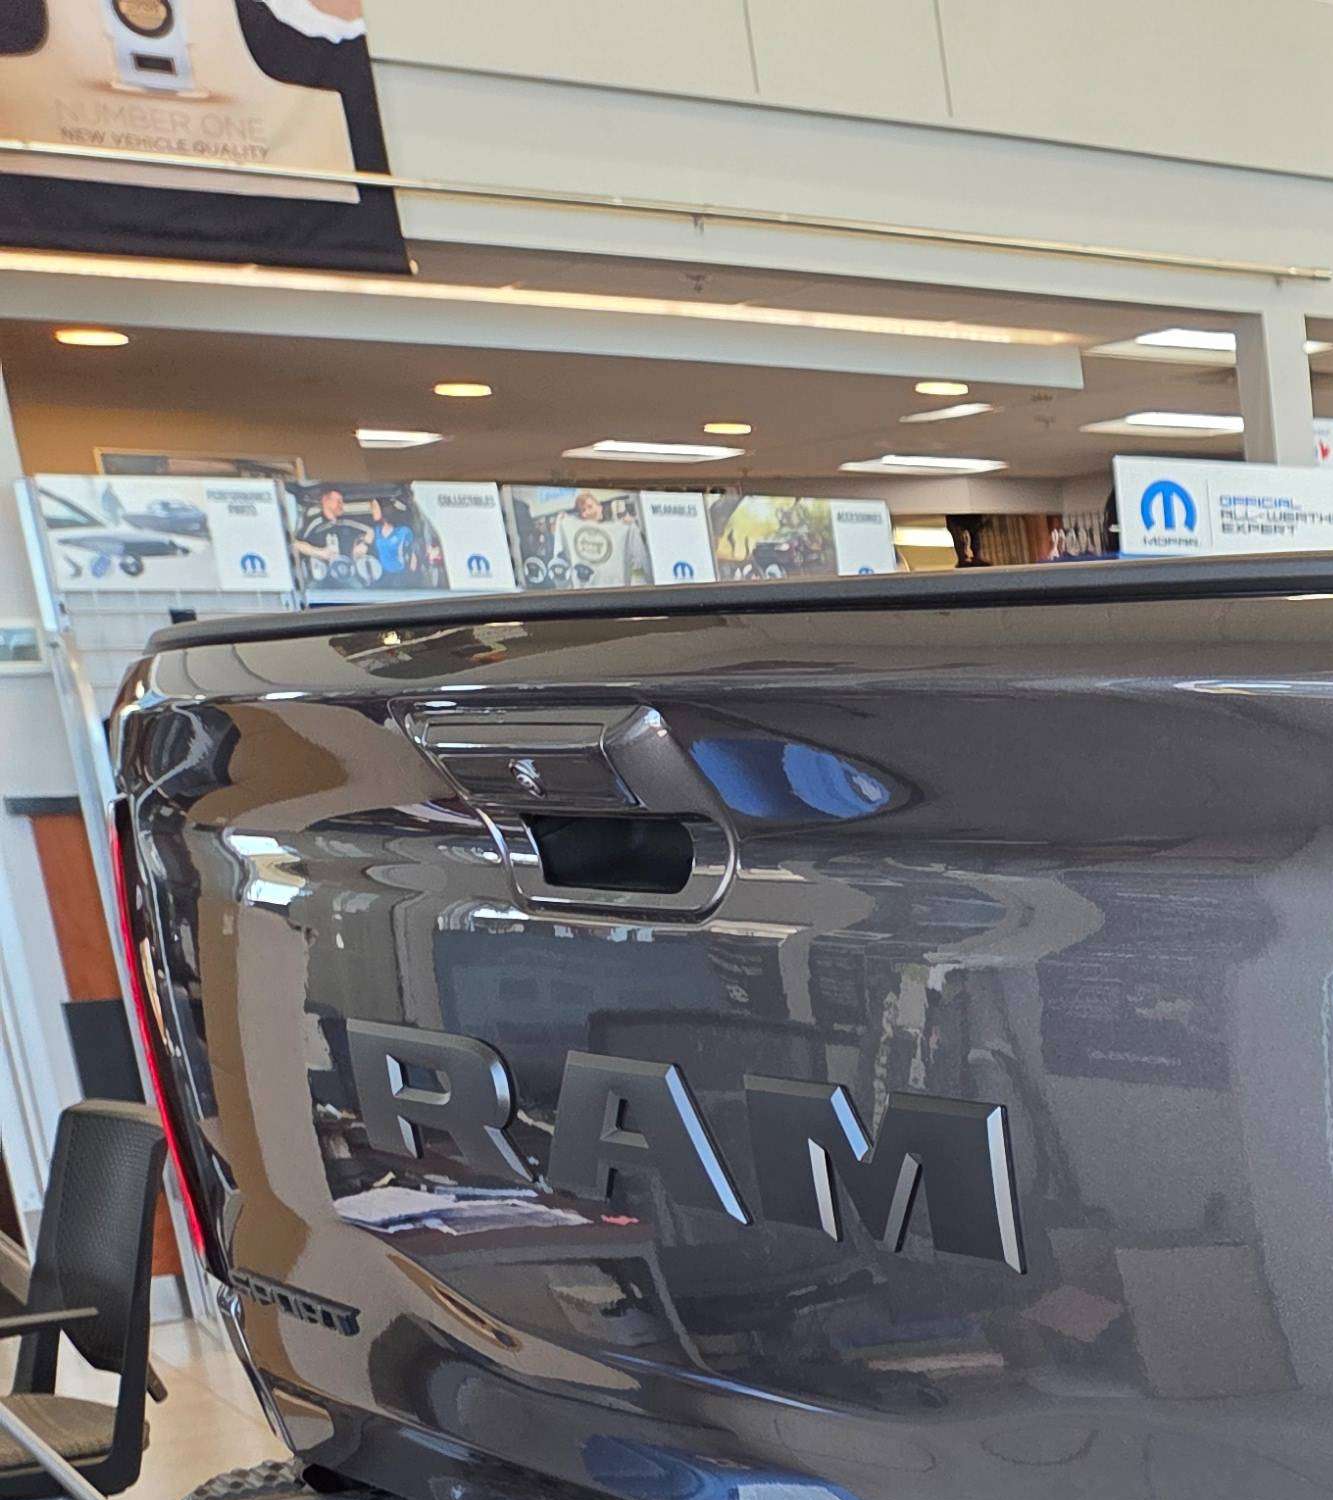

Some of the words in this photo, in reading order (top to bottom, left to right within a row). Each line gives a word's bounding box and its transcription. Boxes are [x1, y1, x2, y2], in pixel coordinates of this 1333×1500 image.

[55, 97, 191, 132] NUMBER
[201, 112, 266, 142] ONE
[1219, 494, 1301, 510] OFFICIAL
[1221, 523, 1296, 538] EXPERT
[1143, 534, 1199, 548] MOPAR
[346, 1017, 1028, 1276] RAM
